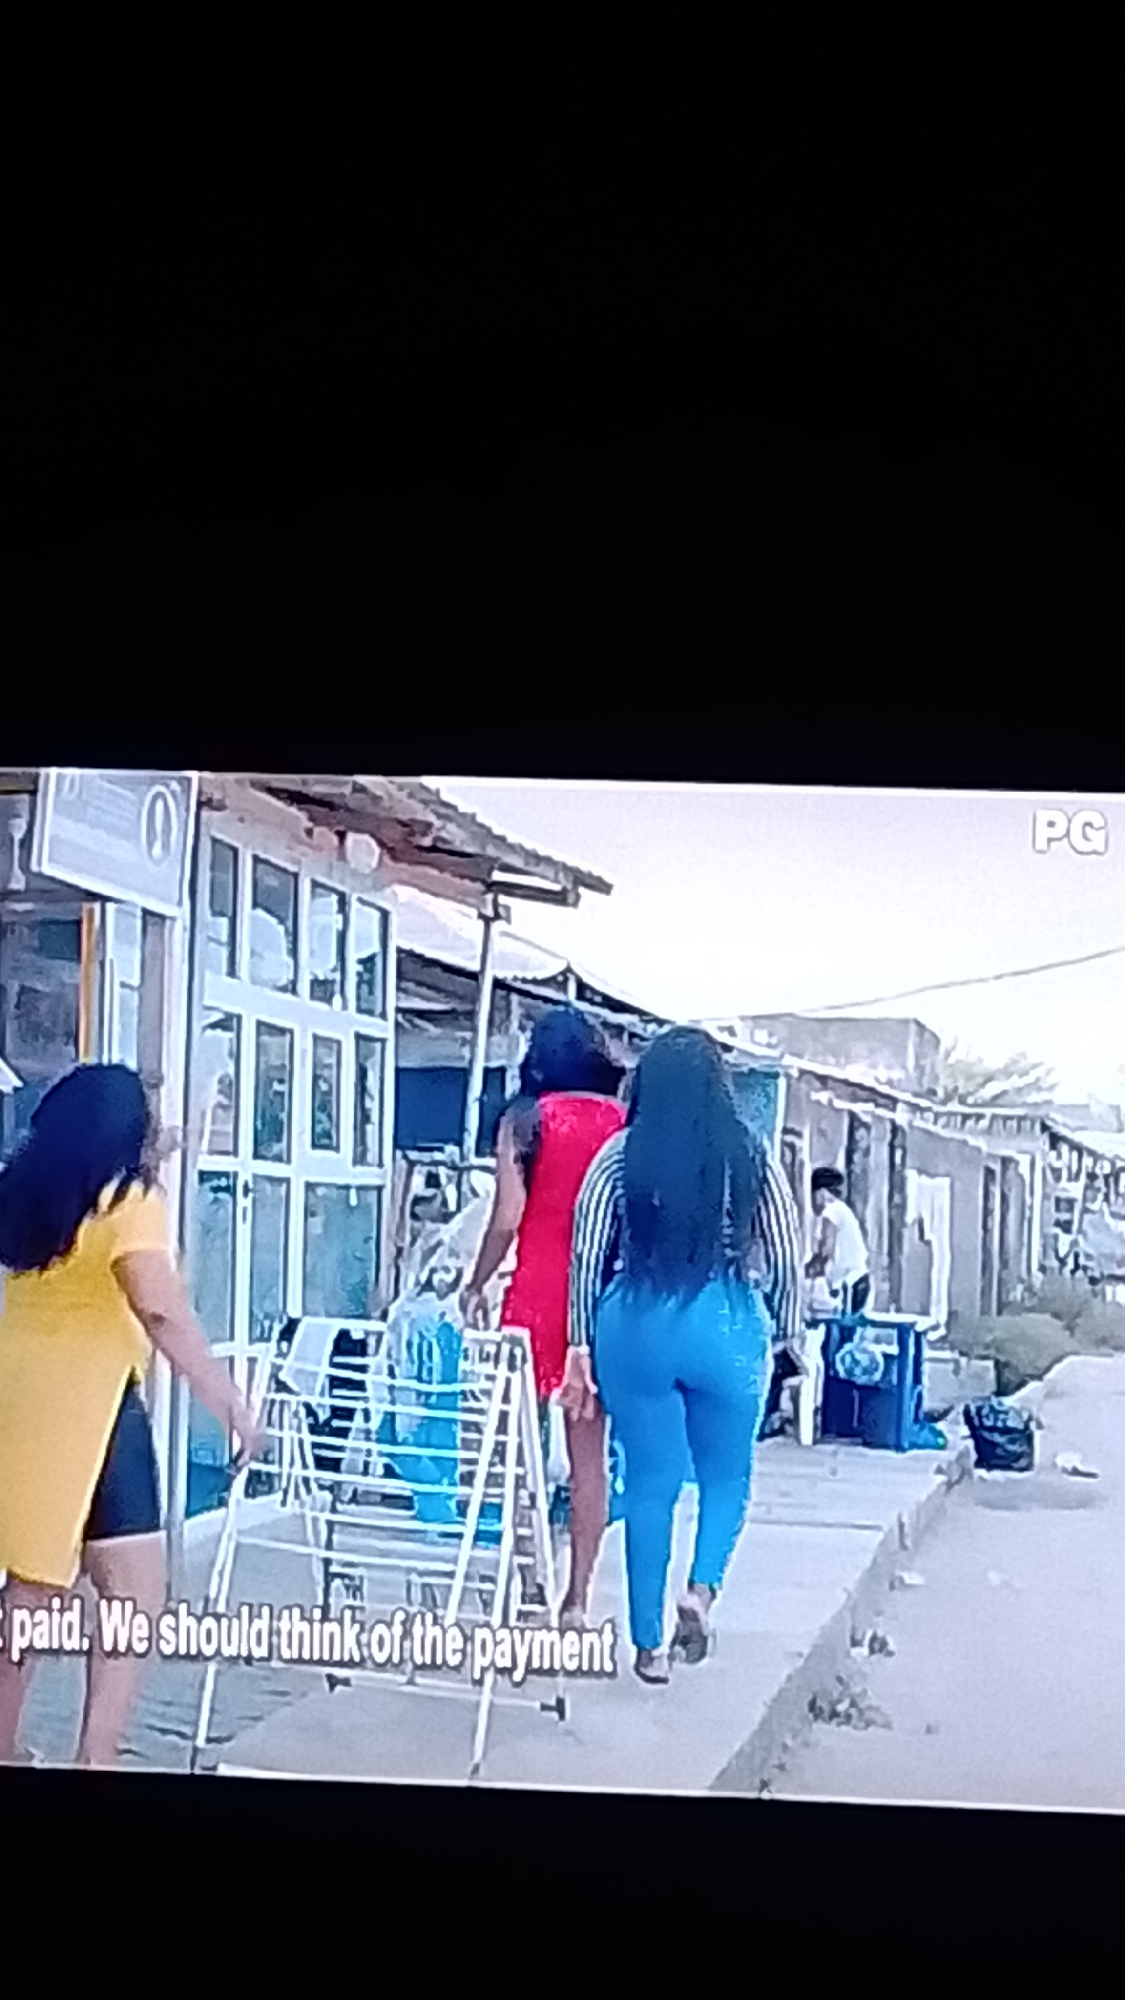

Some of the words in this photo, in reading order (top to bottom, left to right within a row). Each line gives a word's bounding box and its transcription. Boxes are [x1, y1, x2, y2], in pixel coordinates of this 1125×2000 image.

[1033, 808, 1108, 854] PG
[11, 1596, 90, 1663] paid.
[100, 1598, 149, 1655] We
[158, 1602, 270, 1660] should
[278, 1608, 361, 1663] think
[370, 1610, 405, 1664] of
[411, 1611, 463, 1668] the
[472, 1622, 615, 1682] payment
